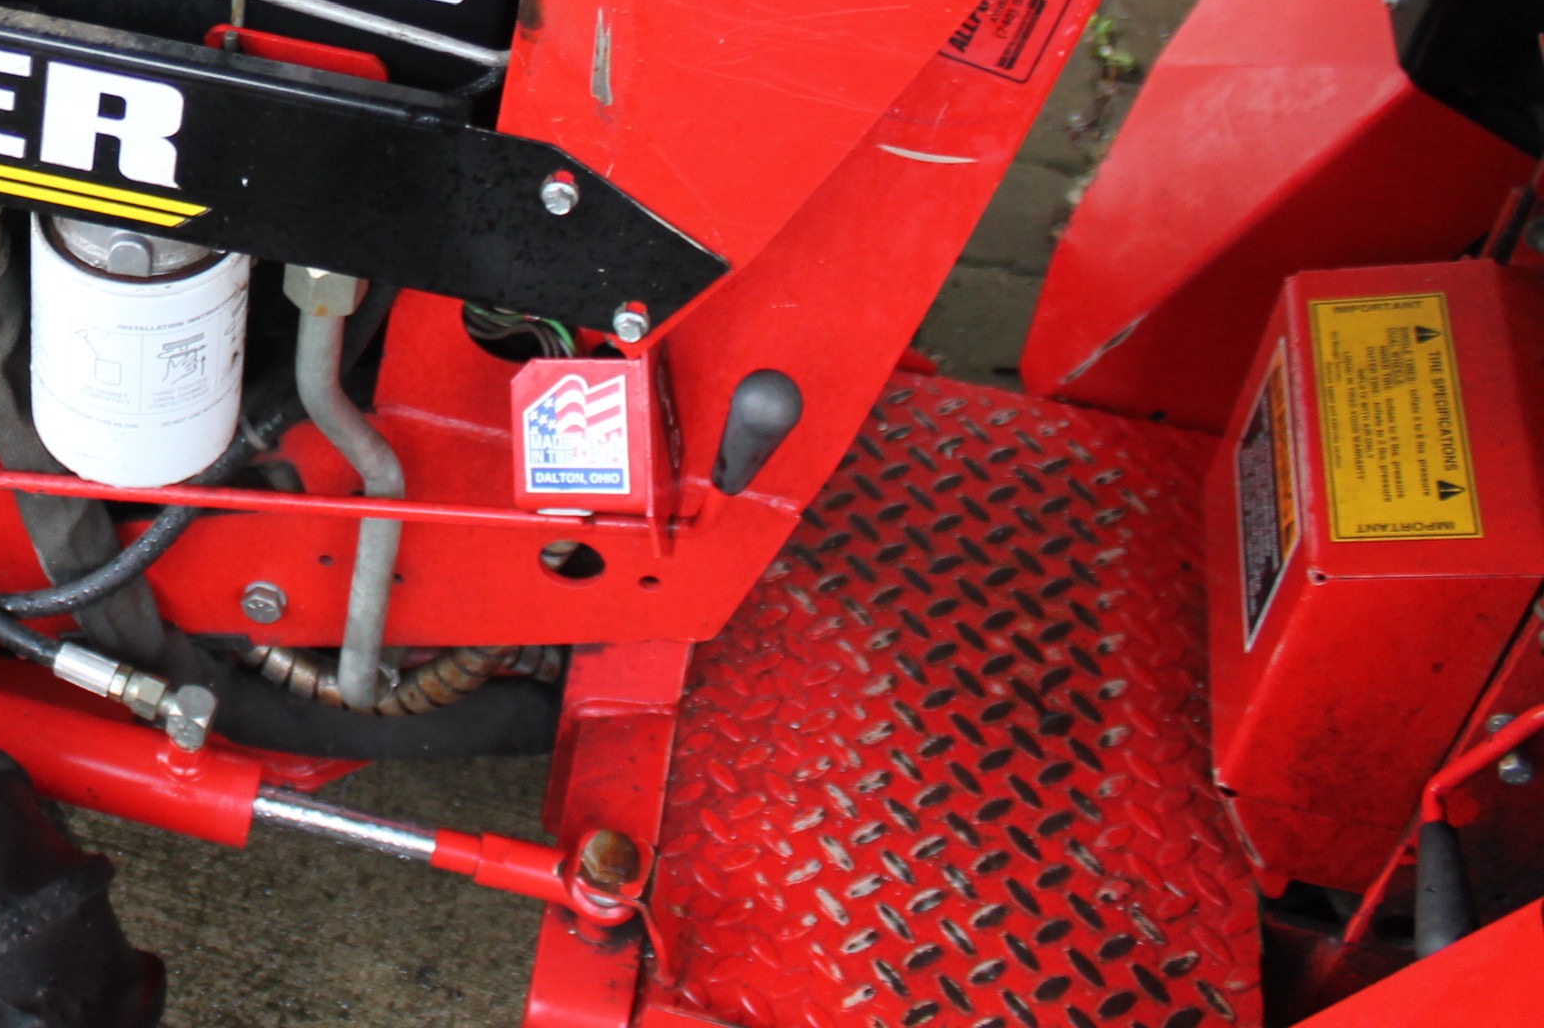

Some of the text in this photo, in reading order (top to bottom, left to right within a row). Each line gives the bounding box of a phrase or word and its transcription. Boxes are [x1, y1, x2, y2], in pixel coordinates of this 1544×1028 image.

[1427, 351, 1458, 471] TIRE SPECIFICATIONS
[1352, 435, 1365, 480] WARRANTY
[534, 471, 621, 485] DALTON, OHIO
[1378, 465, 1392, 502] pressure
[1391, 461, 1405, 498] pressure
[1416, 459, 1431, 496] pressure
[1355, 520, 1456, 533] IMPORTANT
